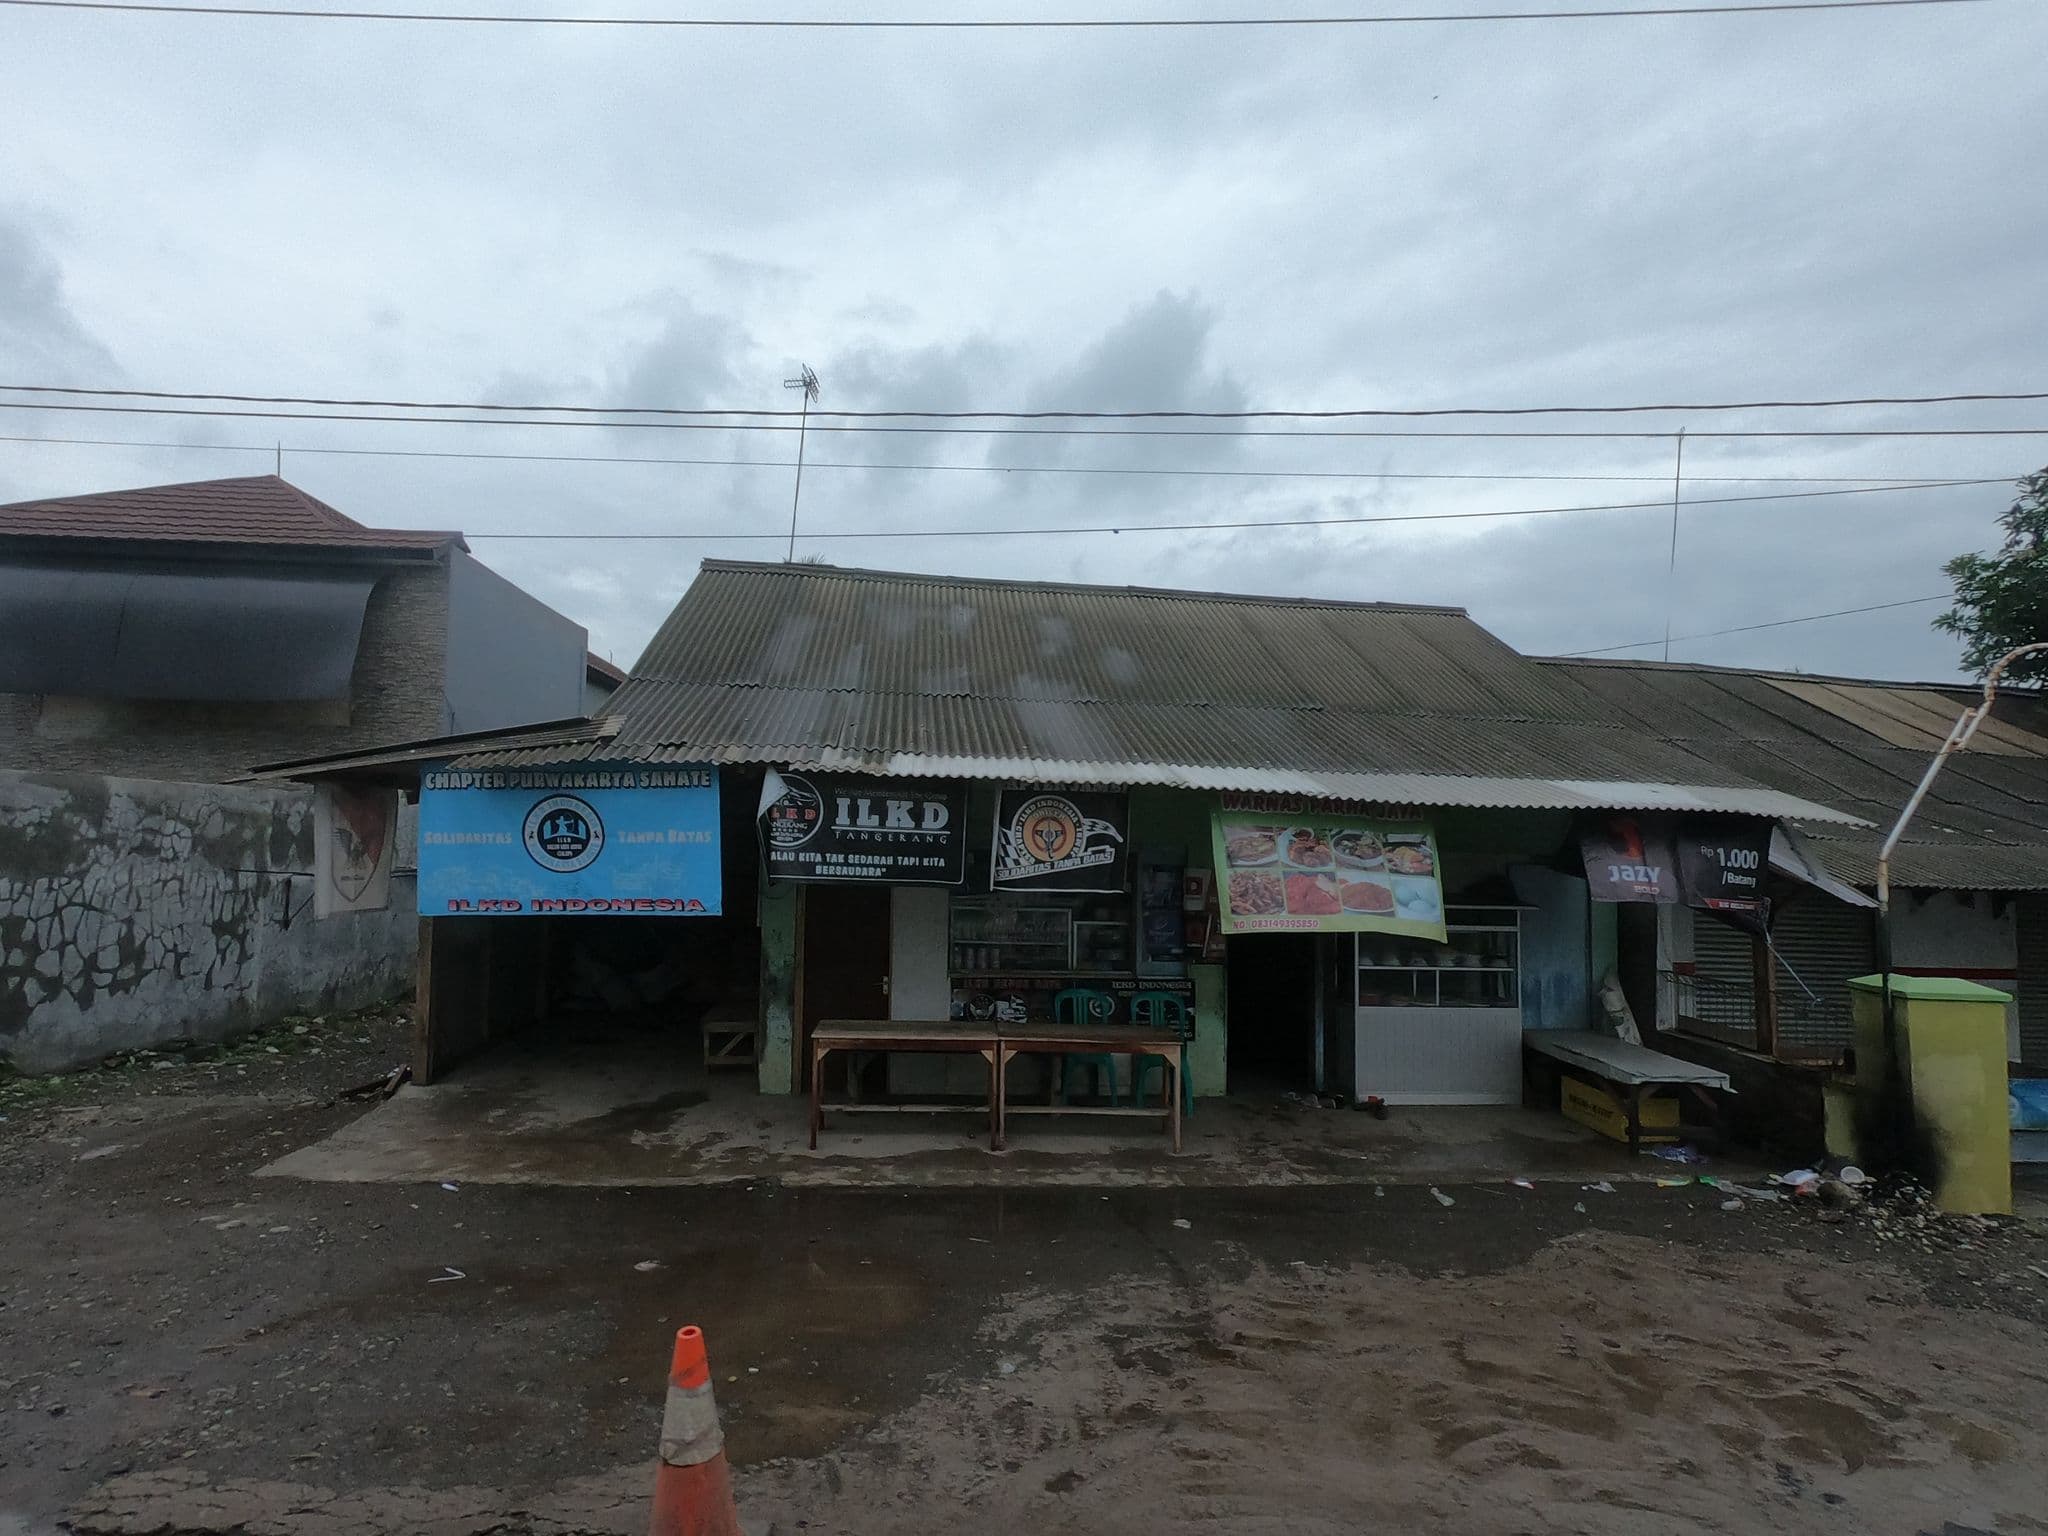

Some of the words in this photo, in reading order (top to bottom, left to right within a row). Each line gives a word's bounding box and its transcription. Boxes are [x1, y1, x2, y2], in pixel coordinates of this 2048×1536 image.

[424, 772, 506, 789] CHAPTER
[509, 771, 636, 789] PURWAKARTA
[835, 797, 950, 829] ILKD
[834, 831, 948, 845] TANGERANG
[798, 852, 822, 863] KITA
[824, 853, 845, 863] TAK
[848, 854, 894, 866] SEDARAH
[897, 856, 919, 867] TAPI
[922, 857, 945, 868] KITA
[996, 862, 1051, 880] SOLIDARITAS
[1053, 856, 1082, 870] TANPA
[1083, 850, 1113, 865] BATAS
[1700, 845, 1714, 859] Rp
[1717, 847, 1759, 870] 1.000
[448, 898, 522, 912] ILKD
[531, 898, 707, 913] INDONESIA
